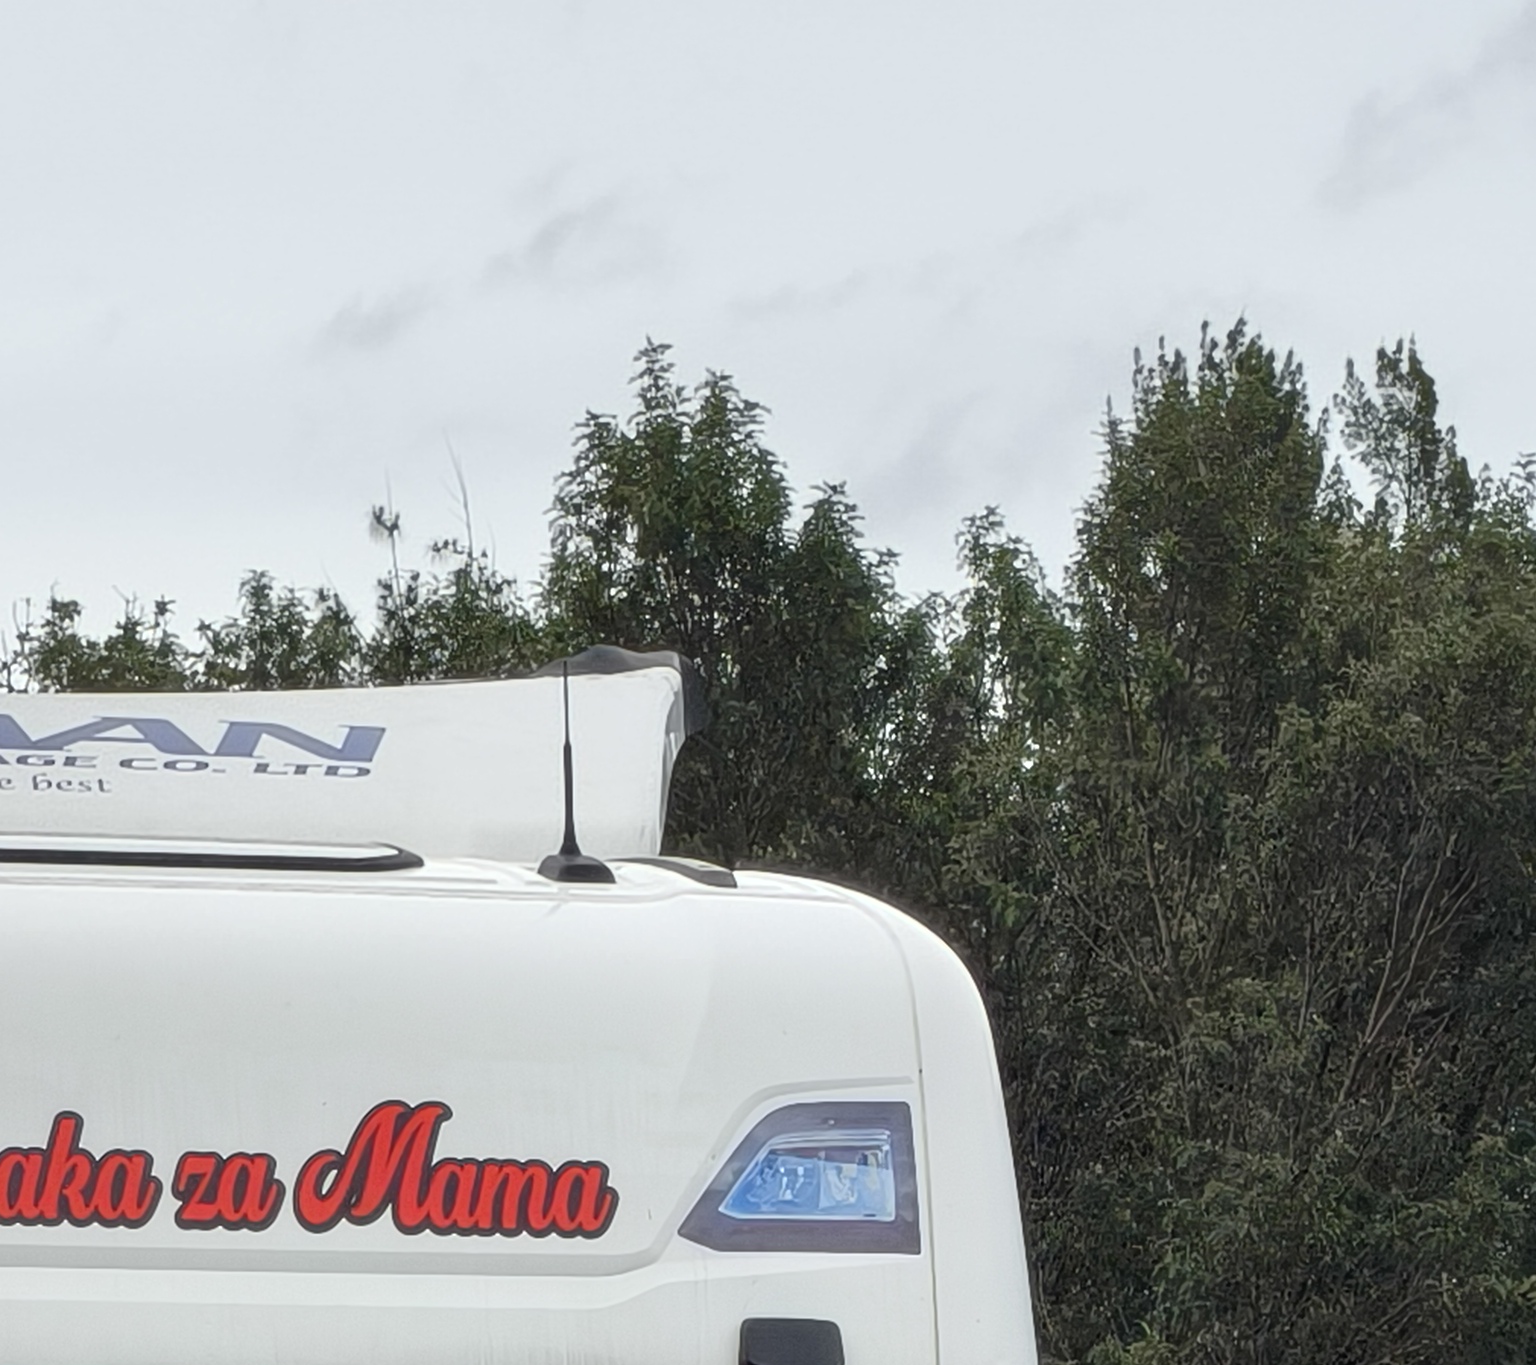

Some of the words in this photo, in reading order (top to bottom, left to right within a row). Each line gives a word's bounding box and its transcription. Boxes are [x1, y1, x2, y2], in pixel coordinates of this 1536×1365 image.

[119, 757, 227, 775] CO.
[253, 762, 372, 778] LTD
[32, 771, 112, 793] best
[172, 1150, 280, 1233] za
[294, 1100, 619, 1239] Mama
